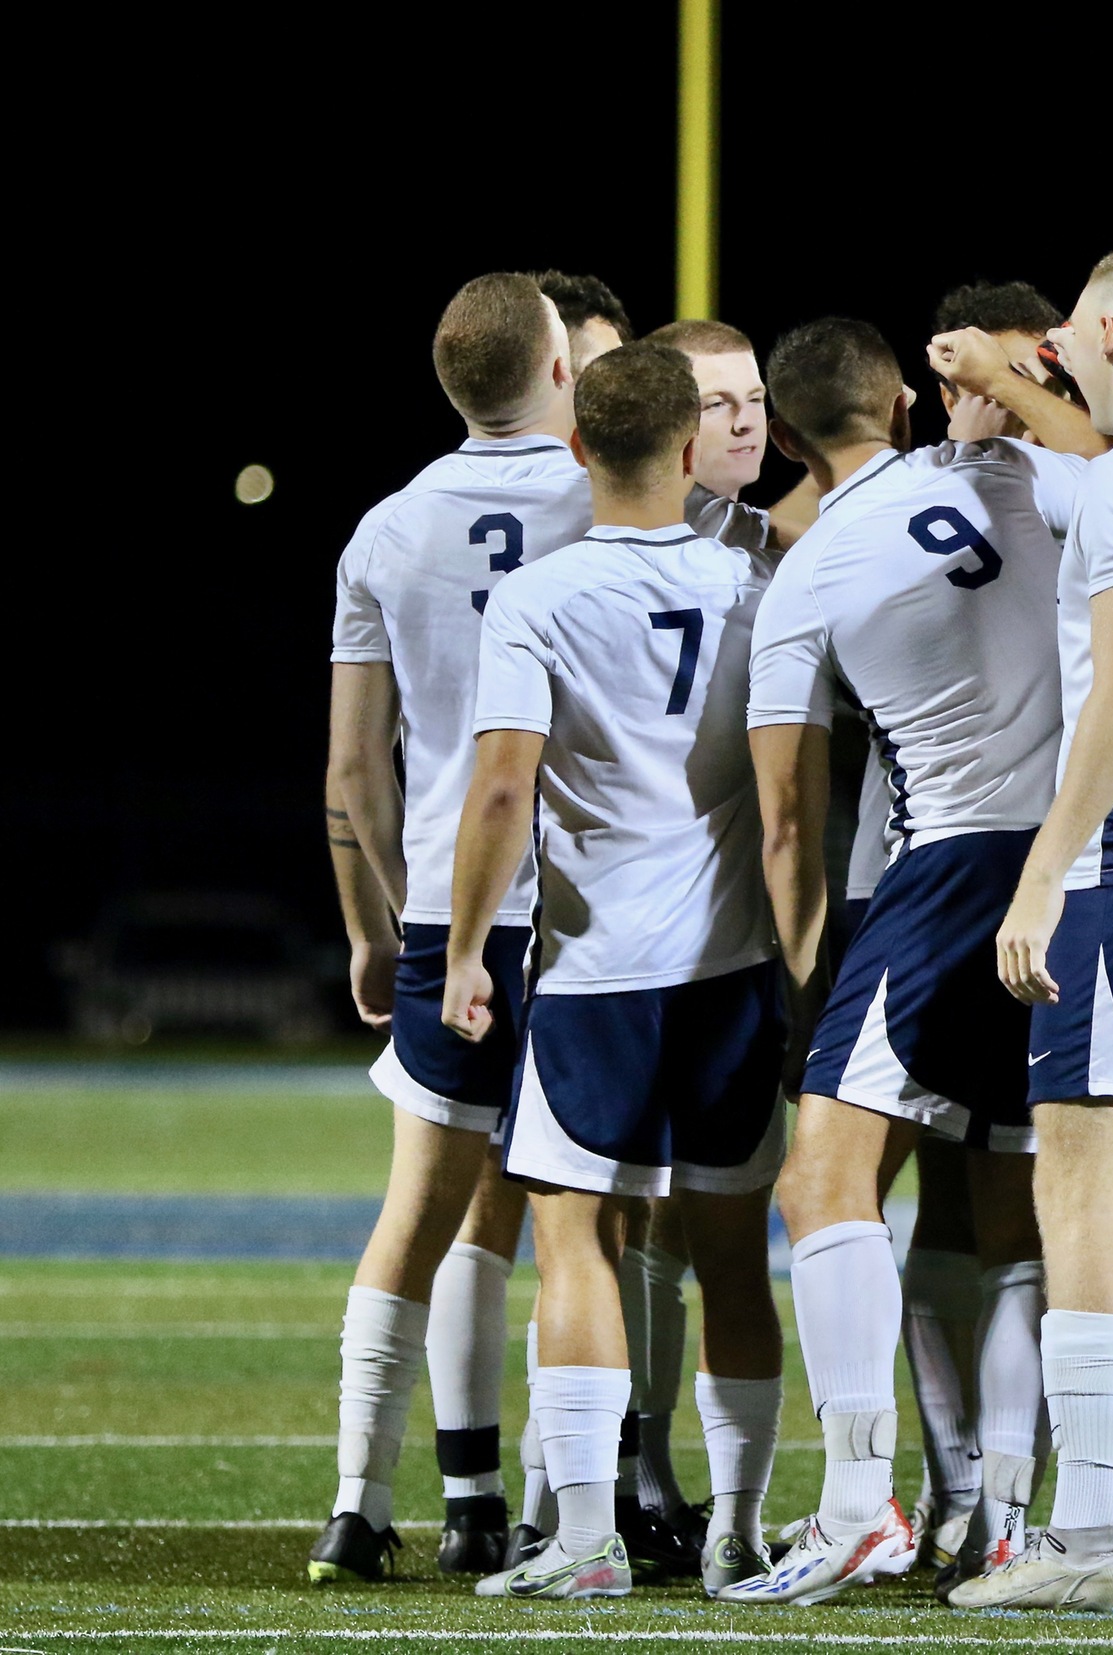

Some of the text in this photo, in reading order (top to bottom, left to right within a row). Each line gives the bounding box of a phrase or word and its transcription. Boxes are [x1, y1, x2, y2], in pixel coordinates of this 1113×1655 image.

[469, 512, 524, 616] 3
[908, 506, 1003, 590] 9
[648, 609, 703, 715] 7
